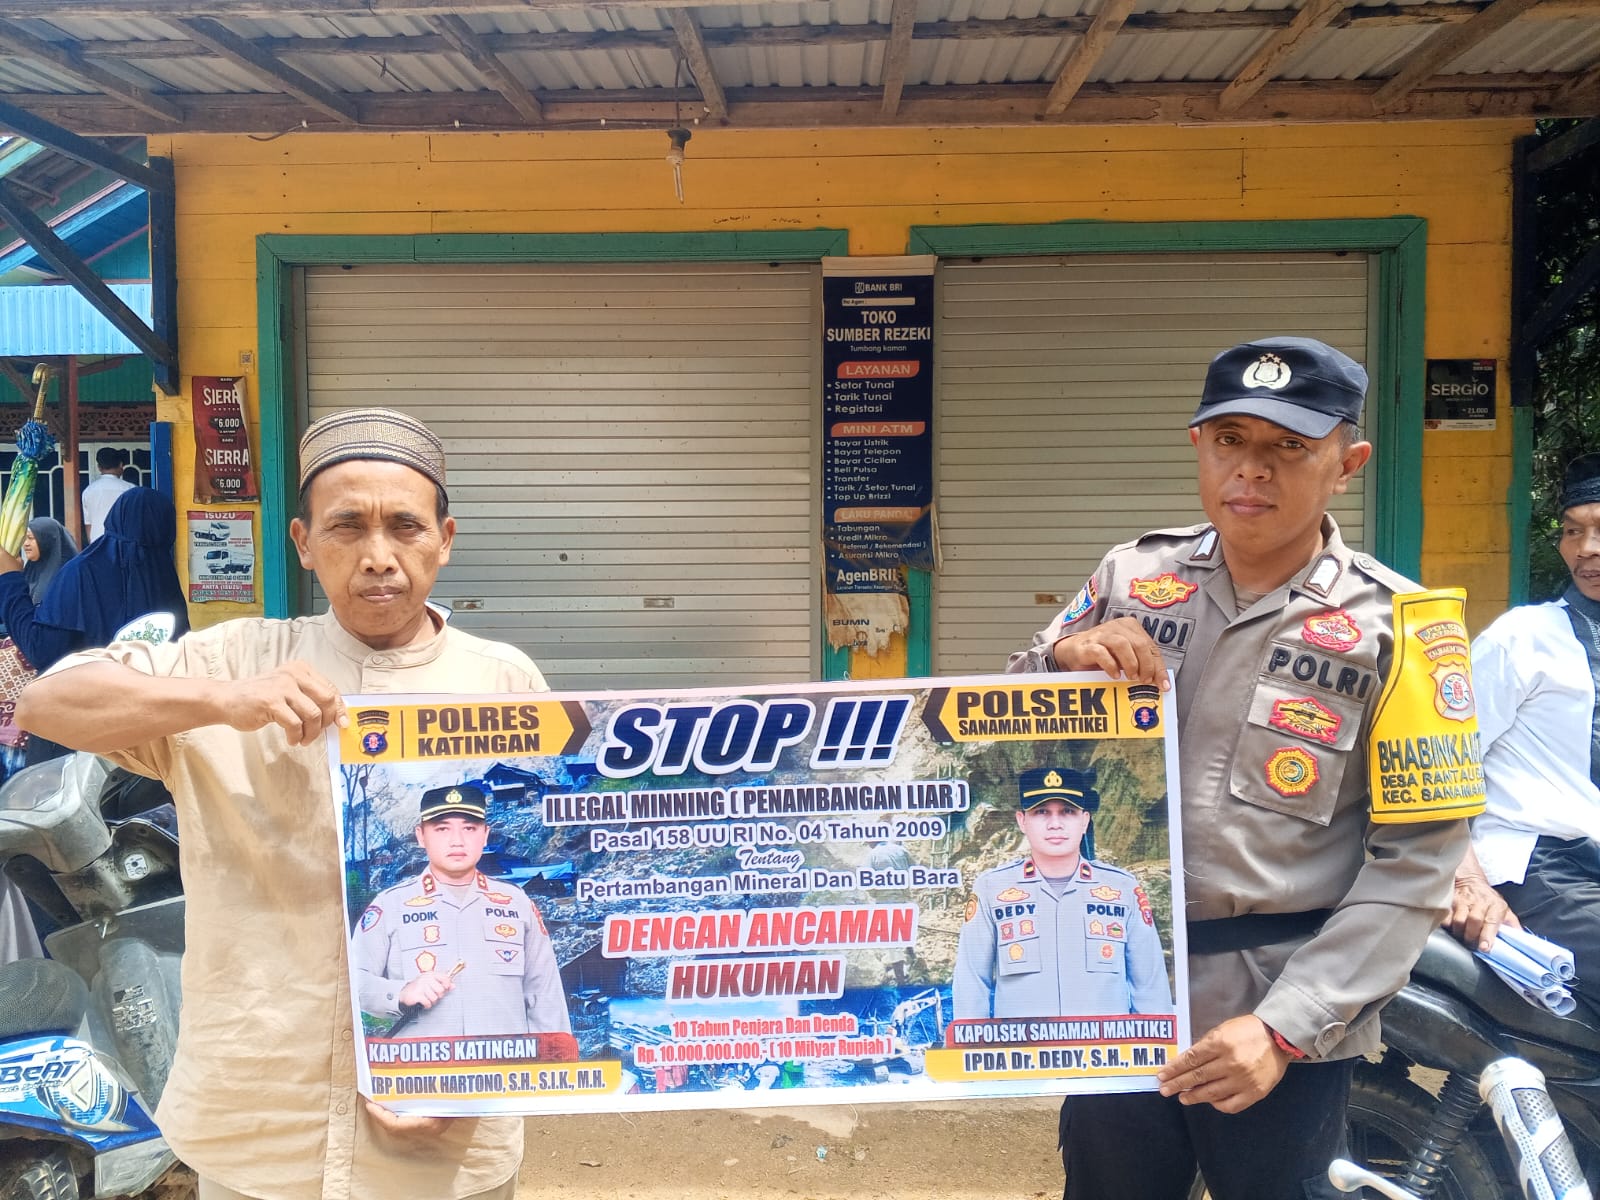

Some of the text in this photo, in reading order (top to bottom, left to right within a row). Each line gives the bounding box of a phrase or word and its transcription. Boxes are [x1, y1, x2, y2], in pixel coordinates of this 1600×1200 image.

[865, 283, 903, 292] BANK BRI
[861, 310, 897, 324] TOKO
[827, 327, 931, 342] SUMBER REZEKI
[850, 345, 882, 354] Tumbang
[846, 364, 910, 376] LAYANAN
[834, 380, 894, 390] Setor Tunai
[1431, 384, 1489, 396] SERGIO
[203, 387, 240, 406] SIERR
[834, 392, 892, 402] Tarik Tunai
[834, 404, 883, 414] Registasi
[843, 424, 913, 434] MINI ATM
[204, 448, 250, 466] SIERRA
[864, 448, 902, 456] Telepon
[834, 458, 862, 466] Bayar
[834, 484, 856, 492] Tarik
[834, 494, 851, 502] Top
[205, 512, 236, 520] ISUZU
[841, 510, 871, 520] LAKU
[837, 524, 880, 534] Tabungan
[838, 534, 862, 542] Kredit
[838, 552, 874, 560] Asuransi
[1268, 646, 1371, 699] POLRI
[956, 687, 1109, 719] POLSEK
[417, 705, 540, 735] POLRES
[959, 716, 1108, 736] SANAMAN MANTIKEI
[417, 733, 540, 757] KATINGAN
[600, 700, 813, 774] STOP
[1380, 772, 1418, 789] DESA
[546, 795, 626, 823] ILLEGAL
[631, 791, 725, 819] MINNING
[743, 785, 902, 814] PENAMBANGAN
[906, 784, 954, 810] LIAR
[1382, 788, 1417, 804] KEC.
[594, 821, 942, 848] Pasal 158 UU RI No. 04 Tahun 2009
[739, 850, 802, 870] Tentang
[580, 870, 959, 898] Pertambangan Mineral Dan Batu Bara
[402, 910, 439, 925] DODIK
[485, 907, 520, 919] POLRI
[994, 904, 1036, 920] DEDY
[1086, 904, 1126, 918] POLRI
[608, 908, 914, 953] DENGAN ANCAMAN
[671, 960, 841, 999] HUKUMAN
[672, 1016, 855, 1038] 10 Tahun Penjara Dan Denda
[954, 1020, 1173, 1044] KAPOLSEK SANAMAN MANTIKEI
[368, 1038, 538, 1064] KAPOLRES KATINGAN
[638, 1046, 658, 1064] Rp.
[777, 1041, 792, 1058] 10
[794, 1040, 836, 1058] Milyar
[838, 1038, 884, 1056] Rupiah
[964, 1052, 1008, 1072] IPDA
[1011, 1051, 1036, 1071] Dr.
[1039, 1050, 1087, 1070] DEDY,
[1090, 1048, 1129, 1068] S.H.,
[396, 1075, 437, 1095] DODIK
[440, 1073, 507, 1094] HARTONO,
[508, 1072, 537, 1093] S.H.,
[538, 1070, 575, 1092] S.I.K.,
[577, 1070, 606, 1090] M.H.
